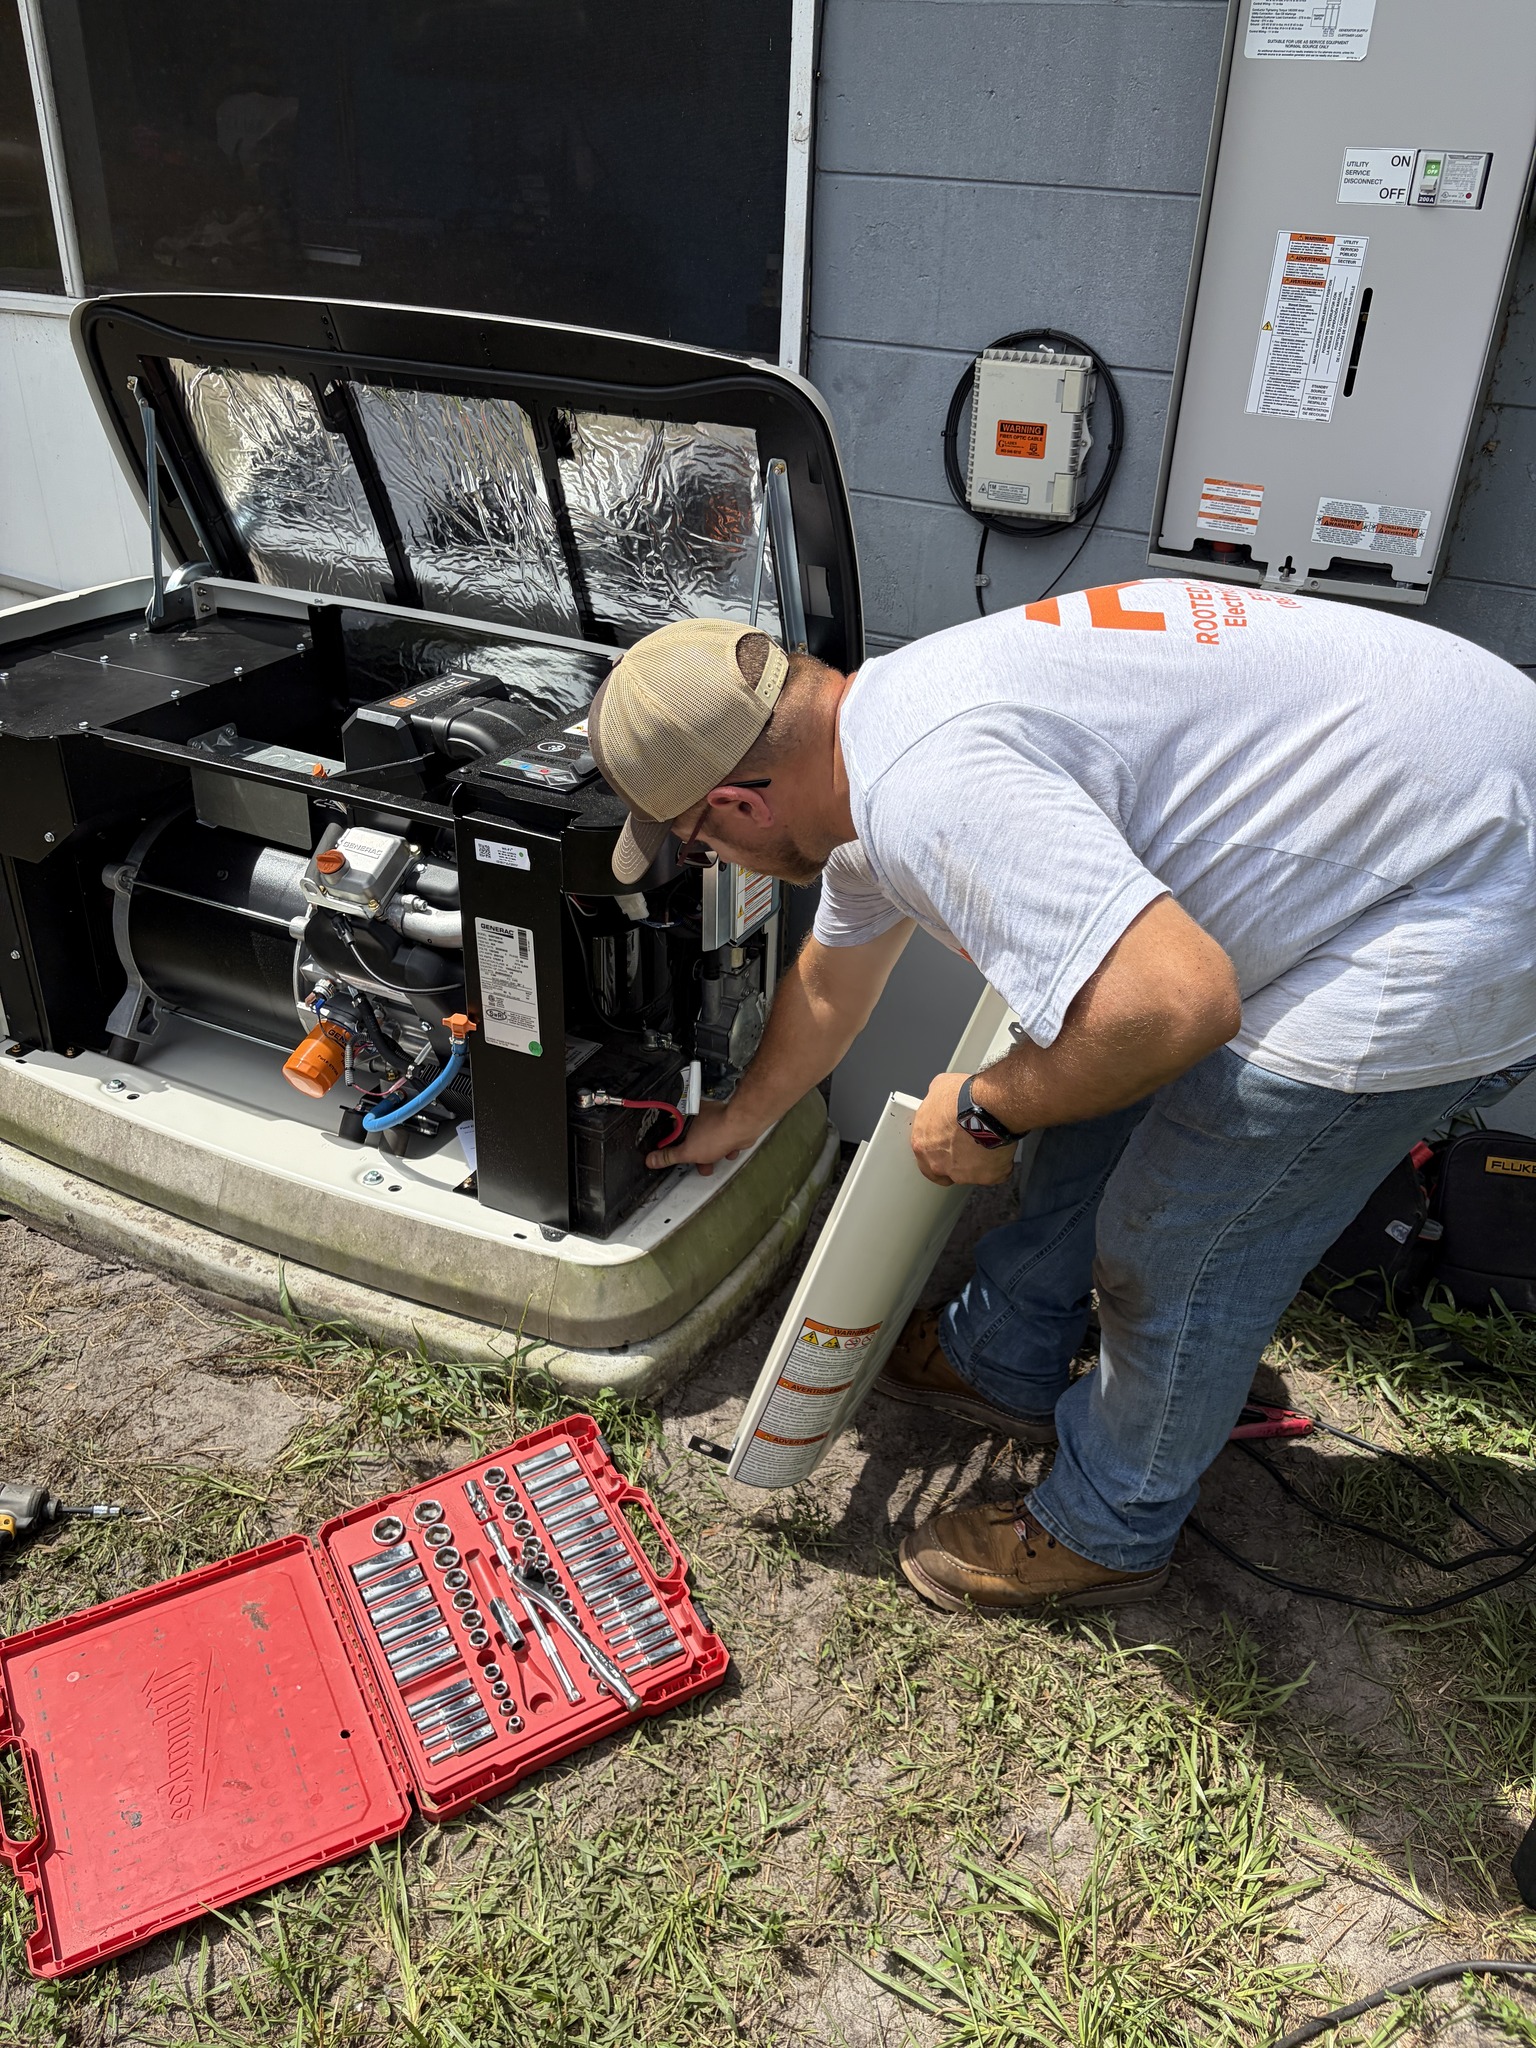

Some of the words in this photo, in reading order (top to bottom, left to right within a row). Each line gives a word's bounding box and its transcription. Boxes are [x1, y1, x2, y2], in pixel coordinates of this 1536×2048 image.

[1391, 155, 1411, 167] ON
[1379, 188, 1406, 199] OFF
[1002, 424, 1041, 434] WARNING
[1186, 586, 1220, 645] ROOTED
[343, 842, 383, 856] GENERAC
[481, 923, 514, 936] GENERAC
